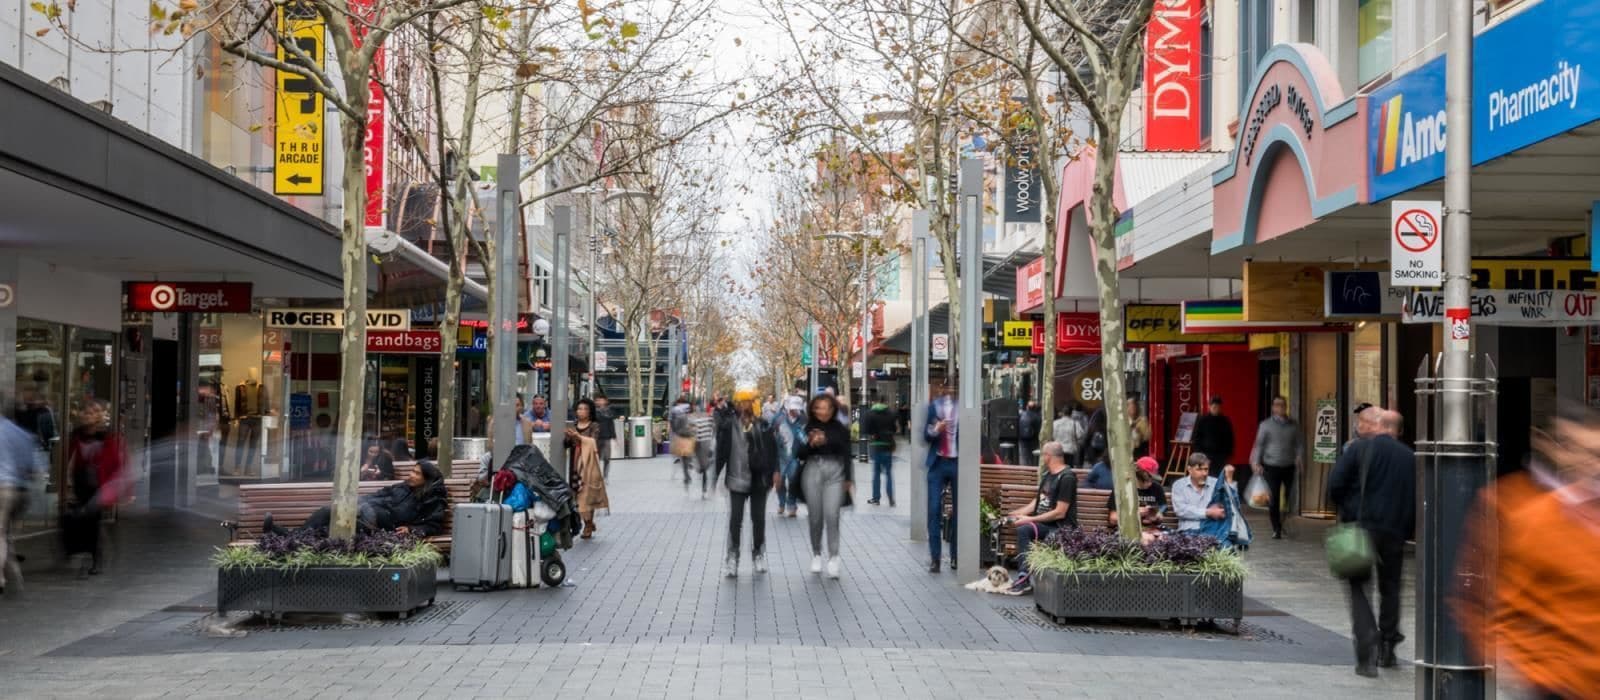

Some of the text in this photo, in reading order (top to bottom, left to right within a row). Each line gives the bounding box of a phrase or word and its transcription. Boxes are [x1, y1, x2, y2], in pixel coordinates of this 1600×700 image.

[1153, 0, 1191, 120] DYM
[1488, 60, 1581, 131] Pharmacity
[280, 142, 319, 152] THRU
[280, 154, 319, 163] ARCADE
[1409, 260, 1423, 268] NO
[1394, 270, 1438, 279] SMOKING
[1507, 291, 1553, 307] INFINITY
[1564, 293, 1598, 317] OUT
[271, 312, 336, 326] ROGER
[1520, 306, 1547, 319] WAR
[424, 366, 433, 385] THE
[424, 388, 433, 416] BODY
[1318, 416, 1330, 435] 25
